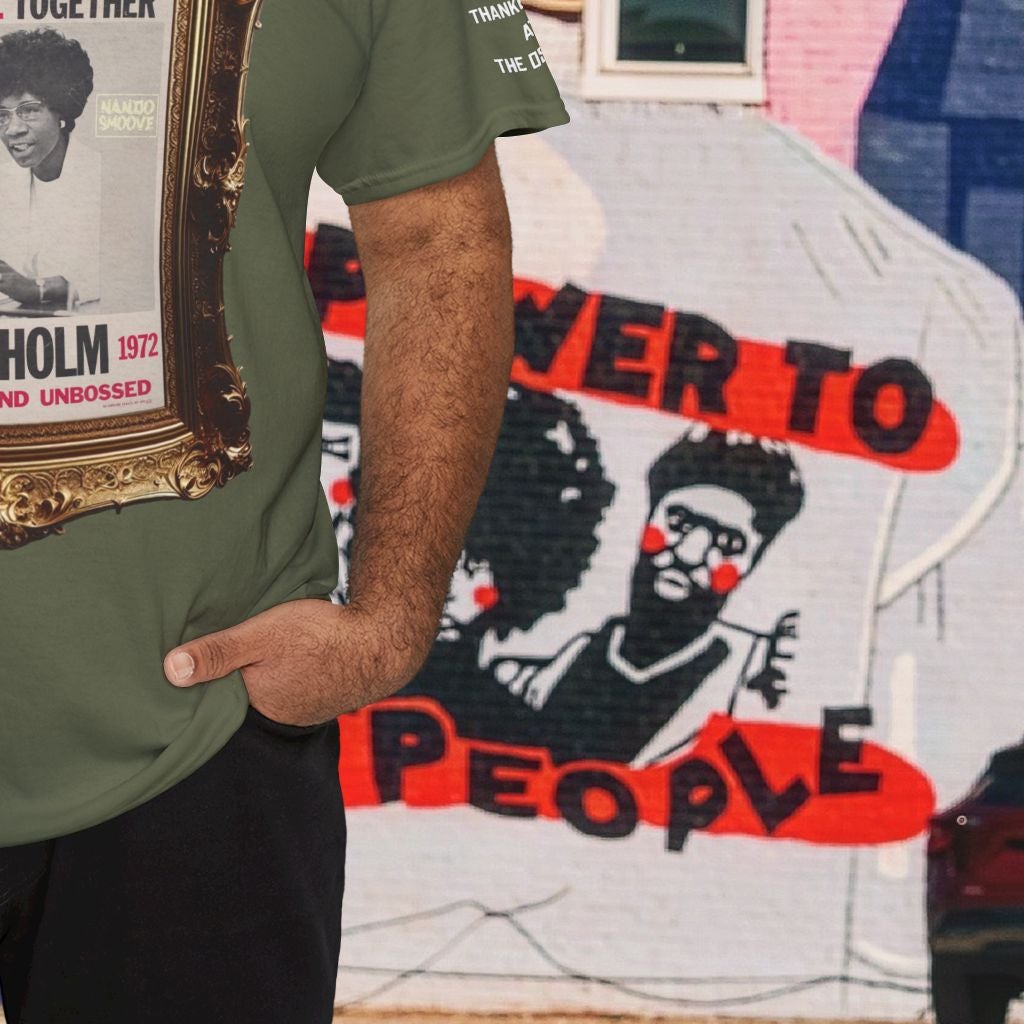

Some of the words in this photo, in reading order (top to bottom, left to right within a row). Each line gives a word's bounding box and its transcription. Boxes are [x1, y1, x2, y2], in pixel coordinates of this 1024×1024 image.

[494, 56, 528, 74] THE
[100, 98, 156, 115] NANDO
[98, 114, 155, 131] SMOOVE
[117, 331, 159, 361] 1972
[312, 223, 739, 414] PWER
[784, 340, 935, 455] TO
[40, 379, 152, 408] UNBOSSED
[368, 705, 882, 853] PEOPLE
